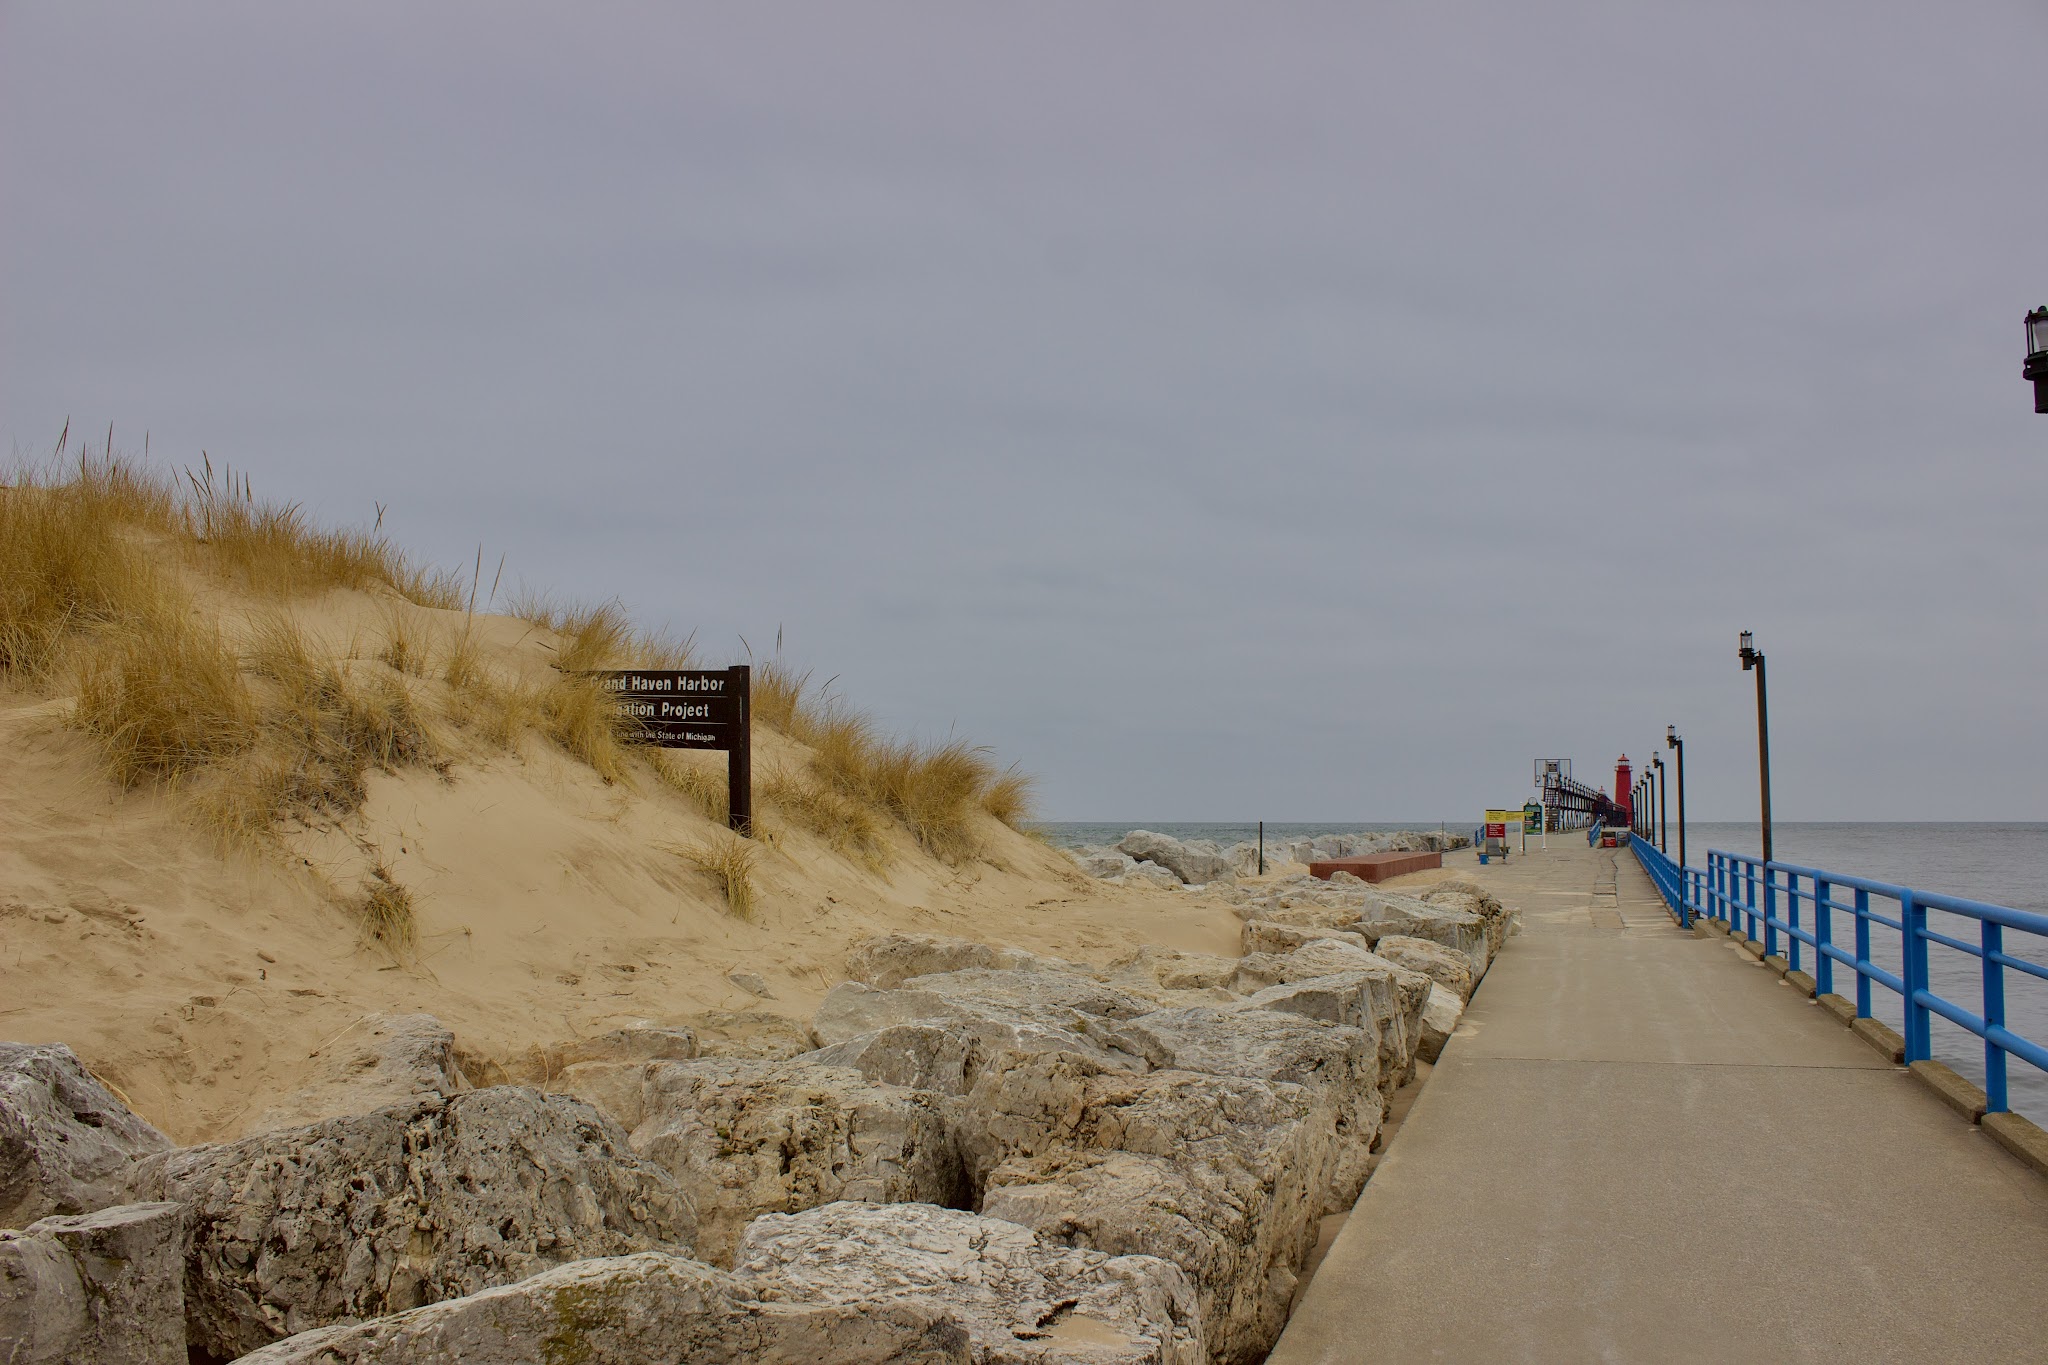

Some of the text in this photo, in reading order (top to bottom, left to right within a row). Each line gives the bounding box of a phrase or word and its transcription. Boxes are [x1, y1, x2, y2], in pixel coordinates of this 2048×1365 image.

[631, 675, 672, 691] Haven
[677, 675, 725, 691] Harbor
[661, 701, 709, 720] Project
[645, 731, 656, 739] the
[657, 730, 676, 740] State
[676, 731, 685, 740] of
[685, 731, 716, 743] Michigan
